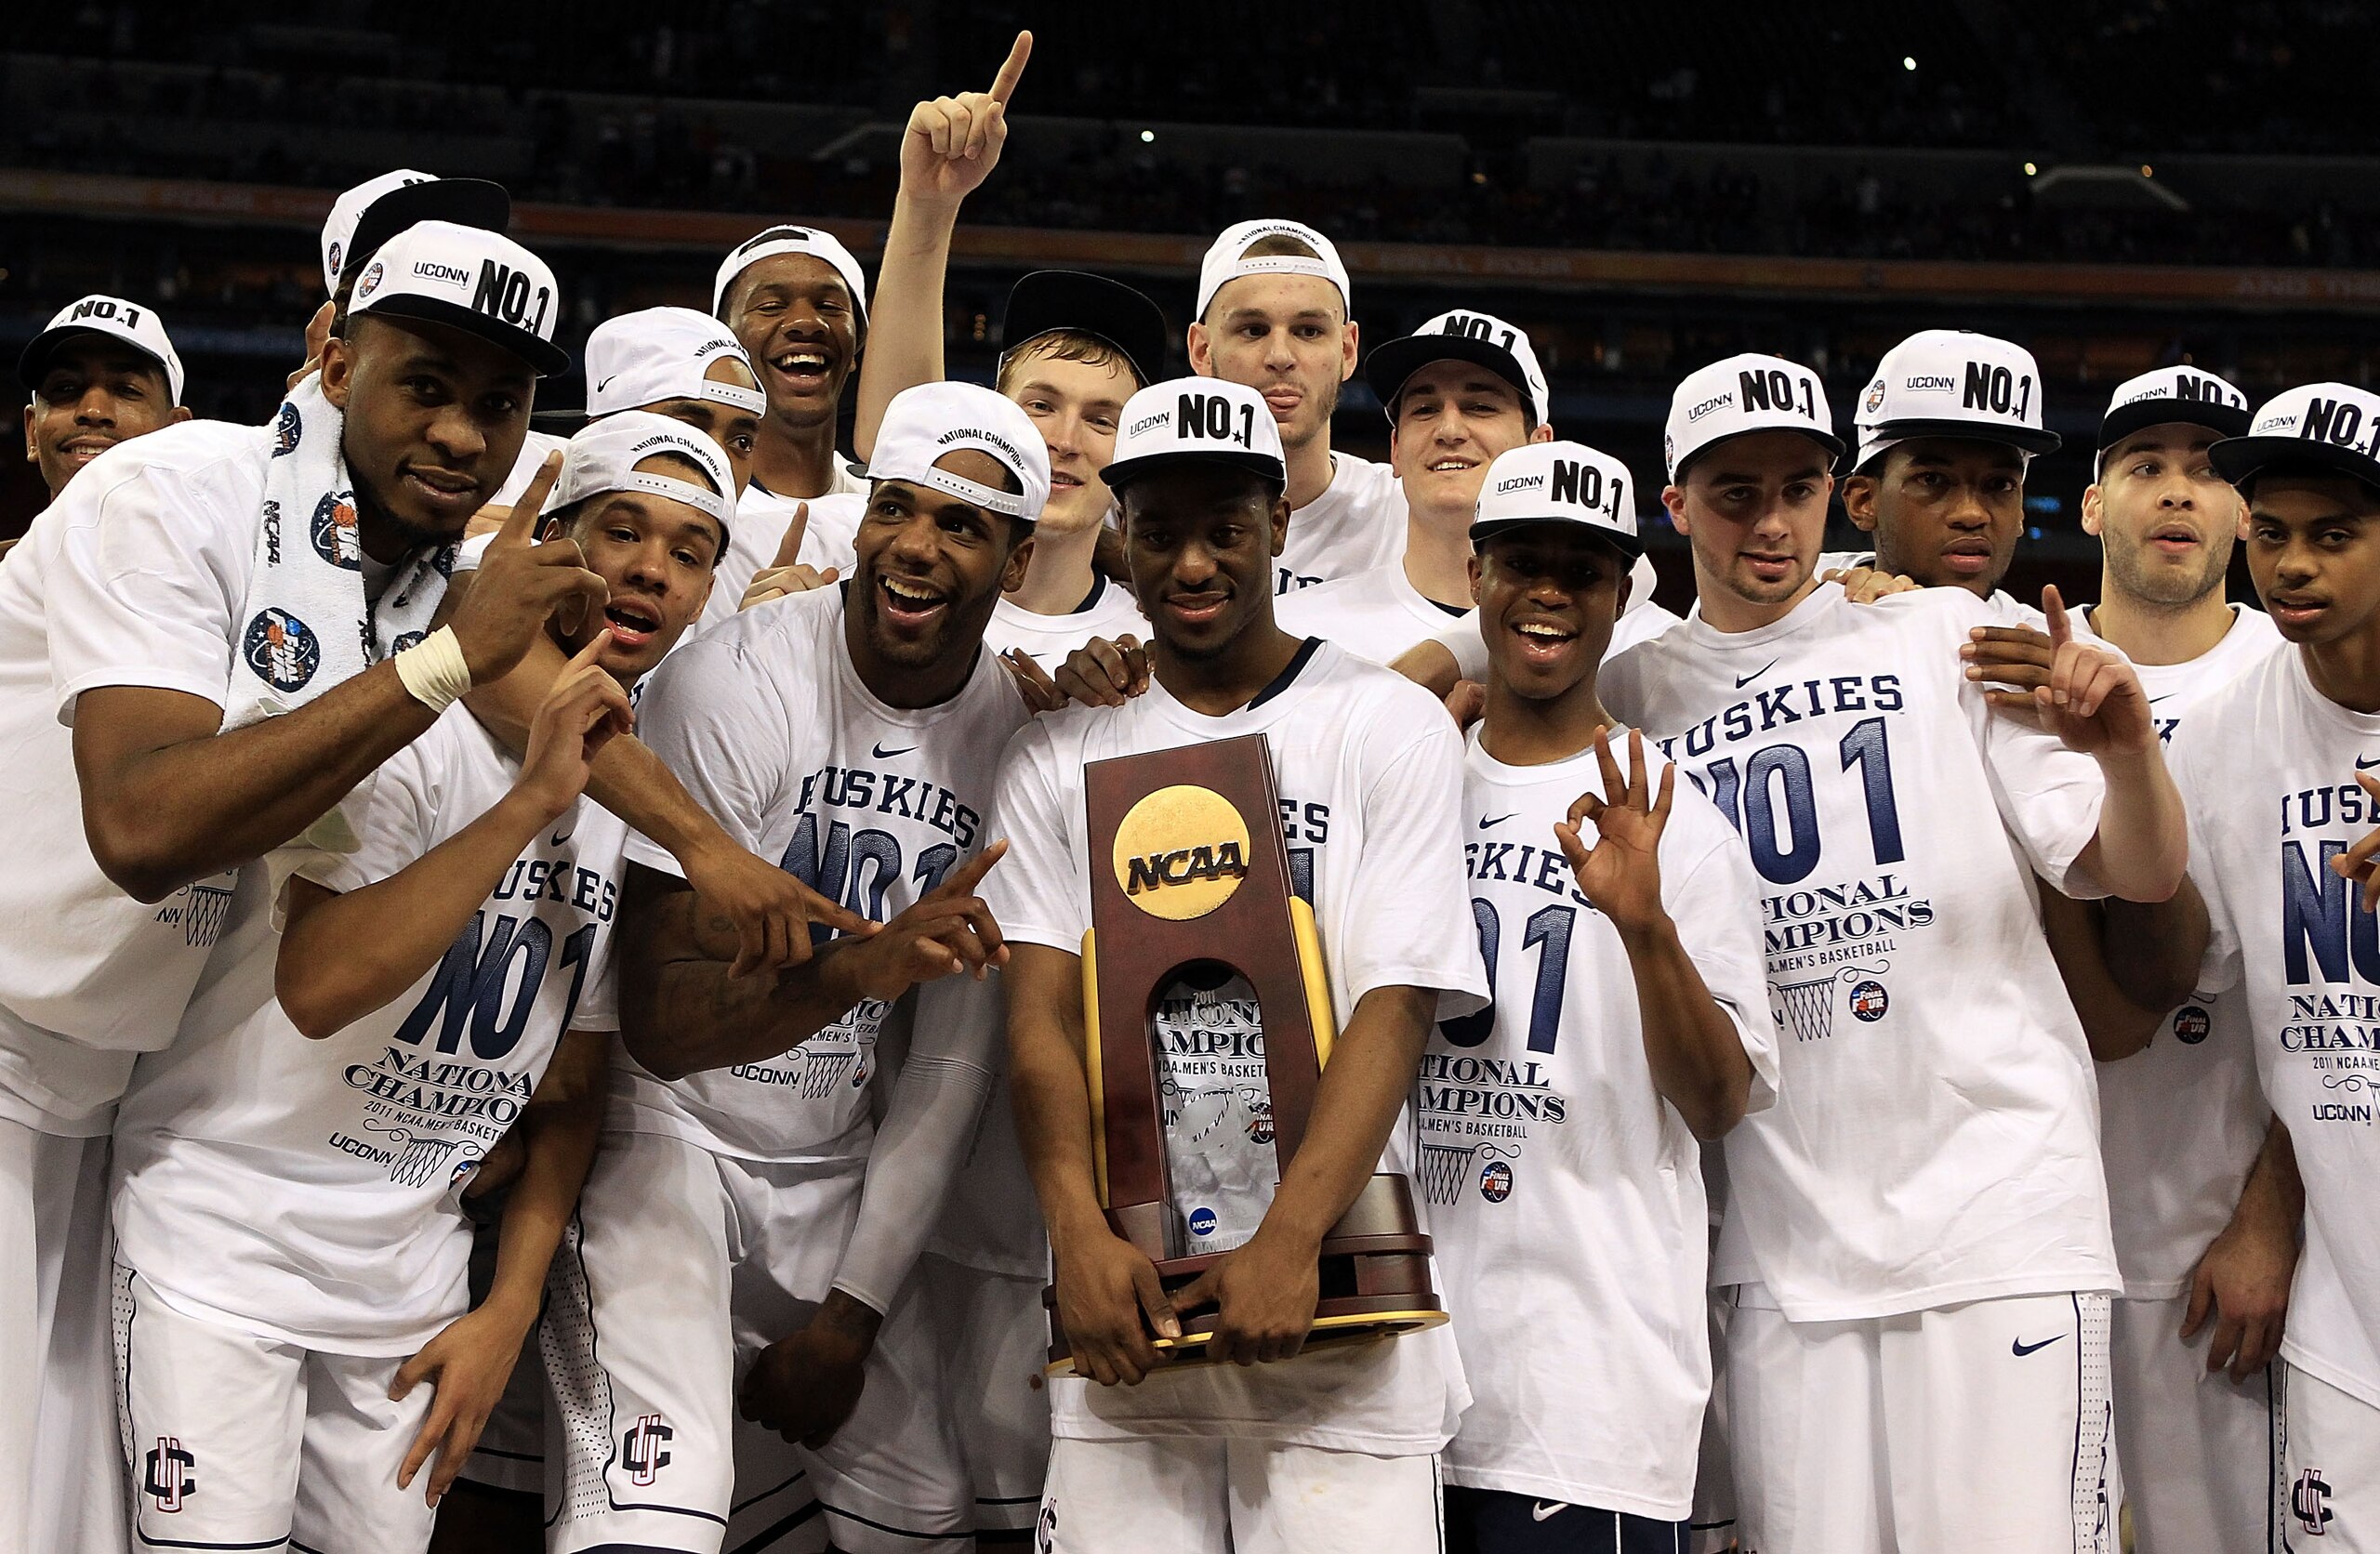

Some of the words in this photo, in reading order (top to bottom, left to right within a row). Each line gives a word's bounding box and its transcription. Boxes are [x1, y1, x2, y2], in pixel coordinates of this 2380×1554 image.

[414, 261, 469, 283] UCONN
[1906, 376, 1955, 391] UCONN
[1688, 391, 1733, 420] UCONN
[1130, 411, 1170, 435] UCONN
[2256, 415, 2298, 431] UCONN
[630, 435, 676, 453] NATIONAL
[677, 436, 721, 478] CHAMPIONS
[937, 428, 983, 445] NATIONAL
[984, 431, 1026, 470] CHAMPIONS
[1498, 475, 1543, 493] UCONN
[1839, 716, 1905, 865] 1
[1127, 840, 1250, 895] NCAA
[1760, 874, 1911, 925] IONAL
[1765, 899, 1937, 955] MPIONS
[1820, 939, 1897, 966] BASKETBALL
[393, 909, 553, 1060] NO
[1522, 903, 1577, 1055] 1
[2290, 994, 2380, 1022] NATI
[373, 1047, 534, 1100] NATIONA
[1221, 1063, 1266, 1078] BASKET
[1421, 1054, 1551, 1092] TIONAL
[2312, 1057, 2333, 1070] 2011
[343, 1065, 522, 1126] CHAMPIO
[364, 1100, 393, 1119] 2011
[1420, 1086, 1567, 1124] MPIONS
[2312, 1104, 2371, 1124] UCONN
[1466, 1123, 1527, 1139] BASKETBALL
[328, 1131, 397, 1166] UCONN
[1192, 1218, 1217, 1231] NCAA
